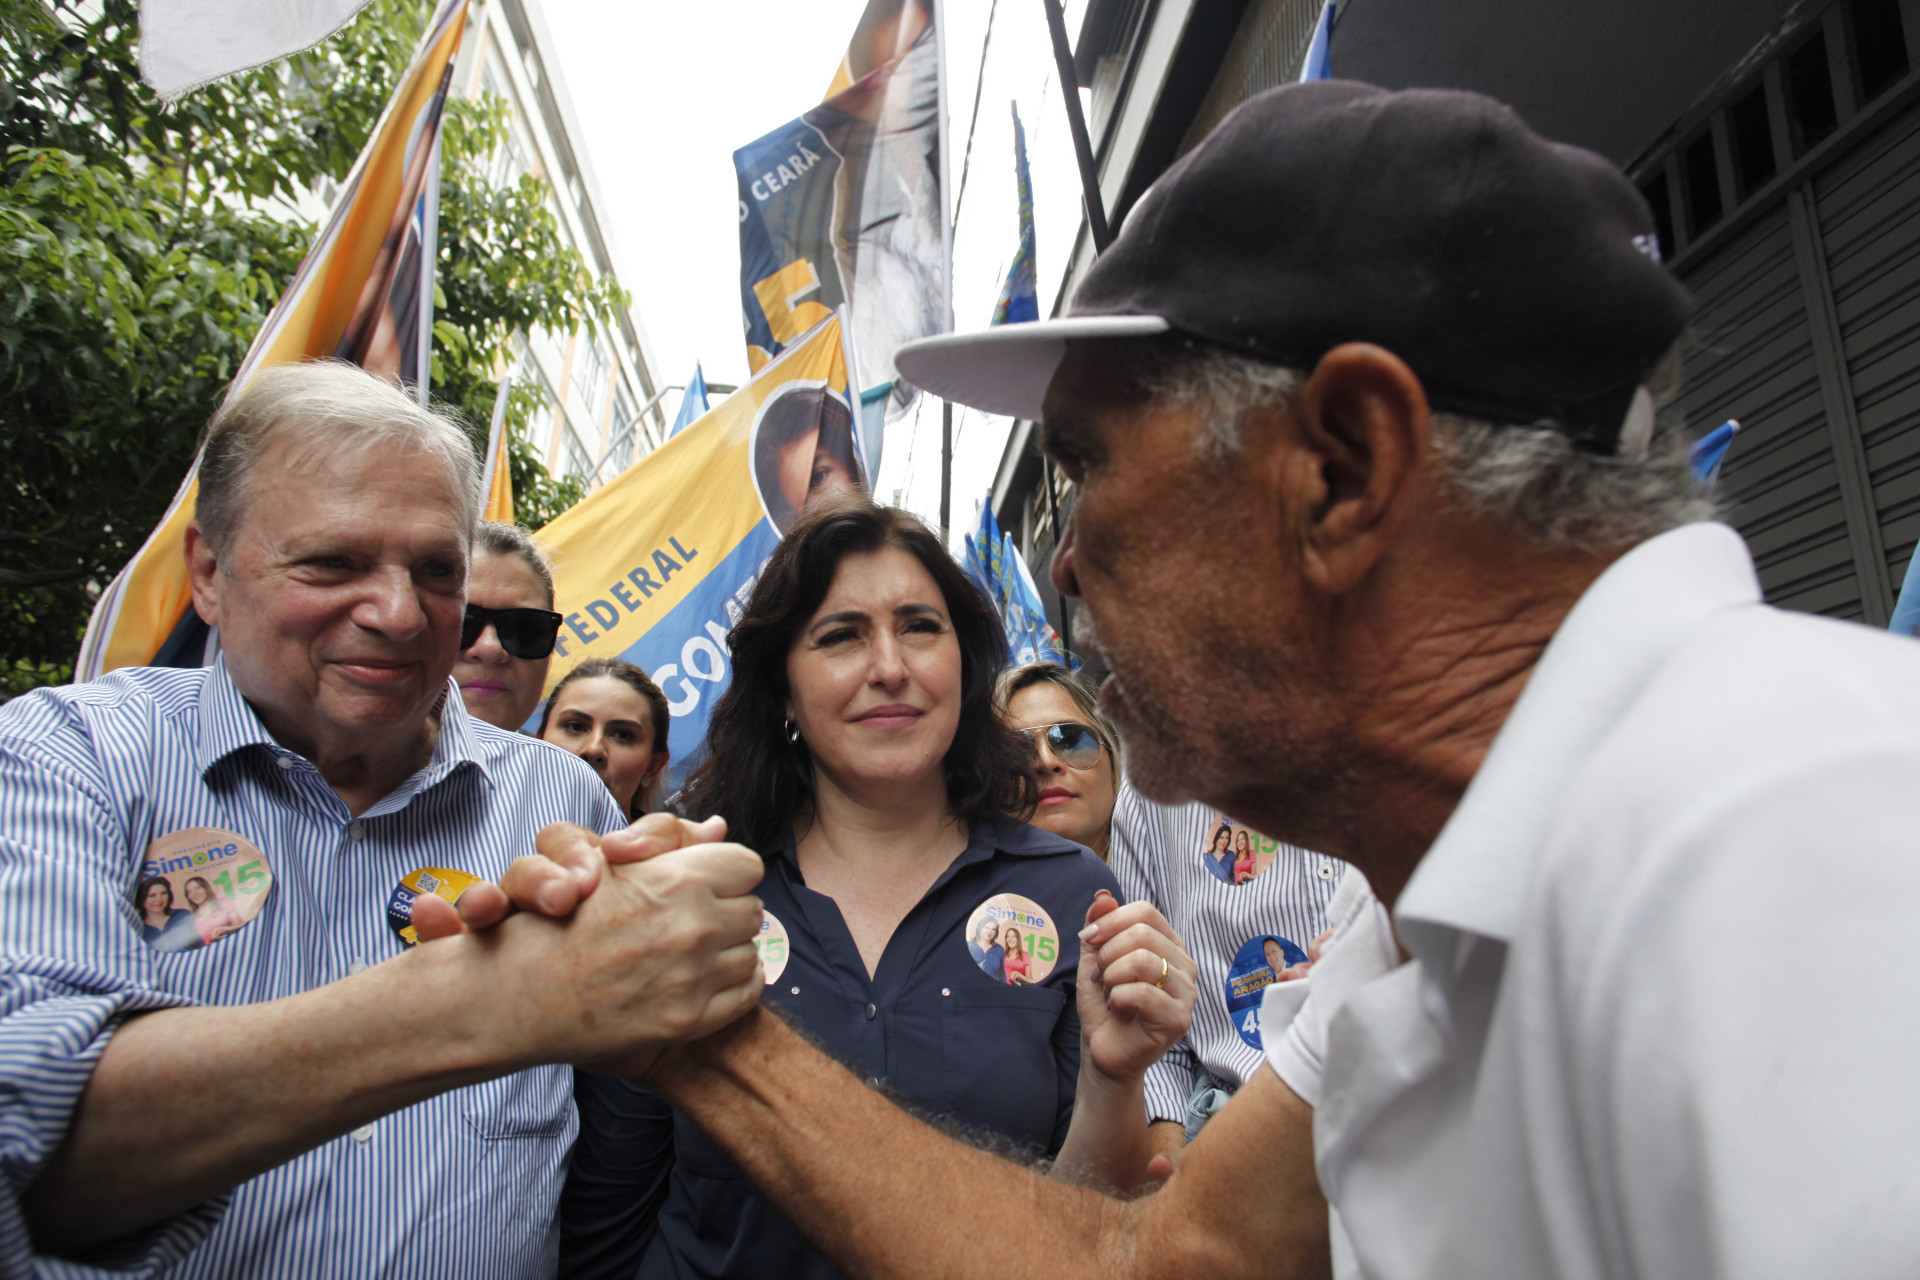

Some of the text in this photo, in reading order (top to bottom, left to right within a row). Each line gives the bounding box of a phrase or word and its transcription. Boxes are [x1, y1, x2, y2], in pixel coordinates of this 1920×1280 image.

[751, 141, 821, 201] CEARÁ
[143, 843, 238, 879] Simone
[213, 859, 268, 900] 15
[986, 906, 1045, 928] Simone
[399, 925, 423, 946] 4
[1023, 933, 1056, 962] 15
[1231, 969, 1272, 988] FERREIRA
[1241, 1007, 1262, 1034] 4
